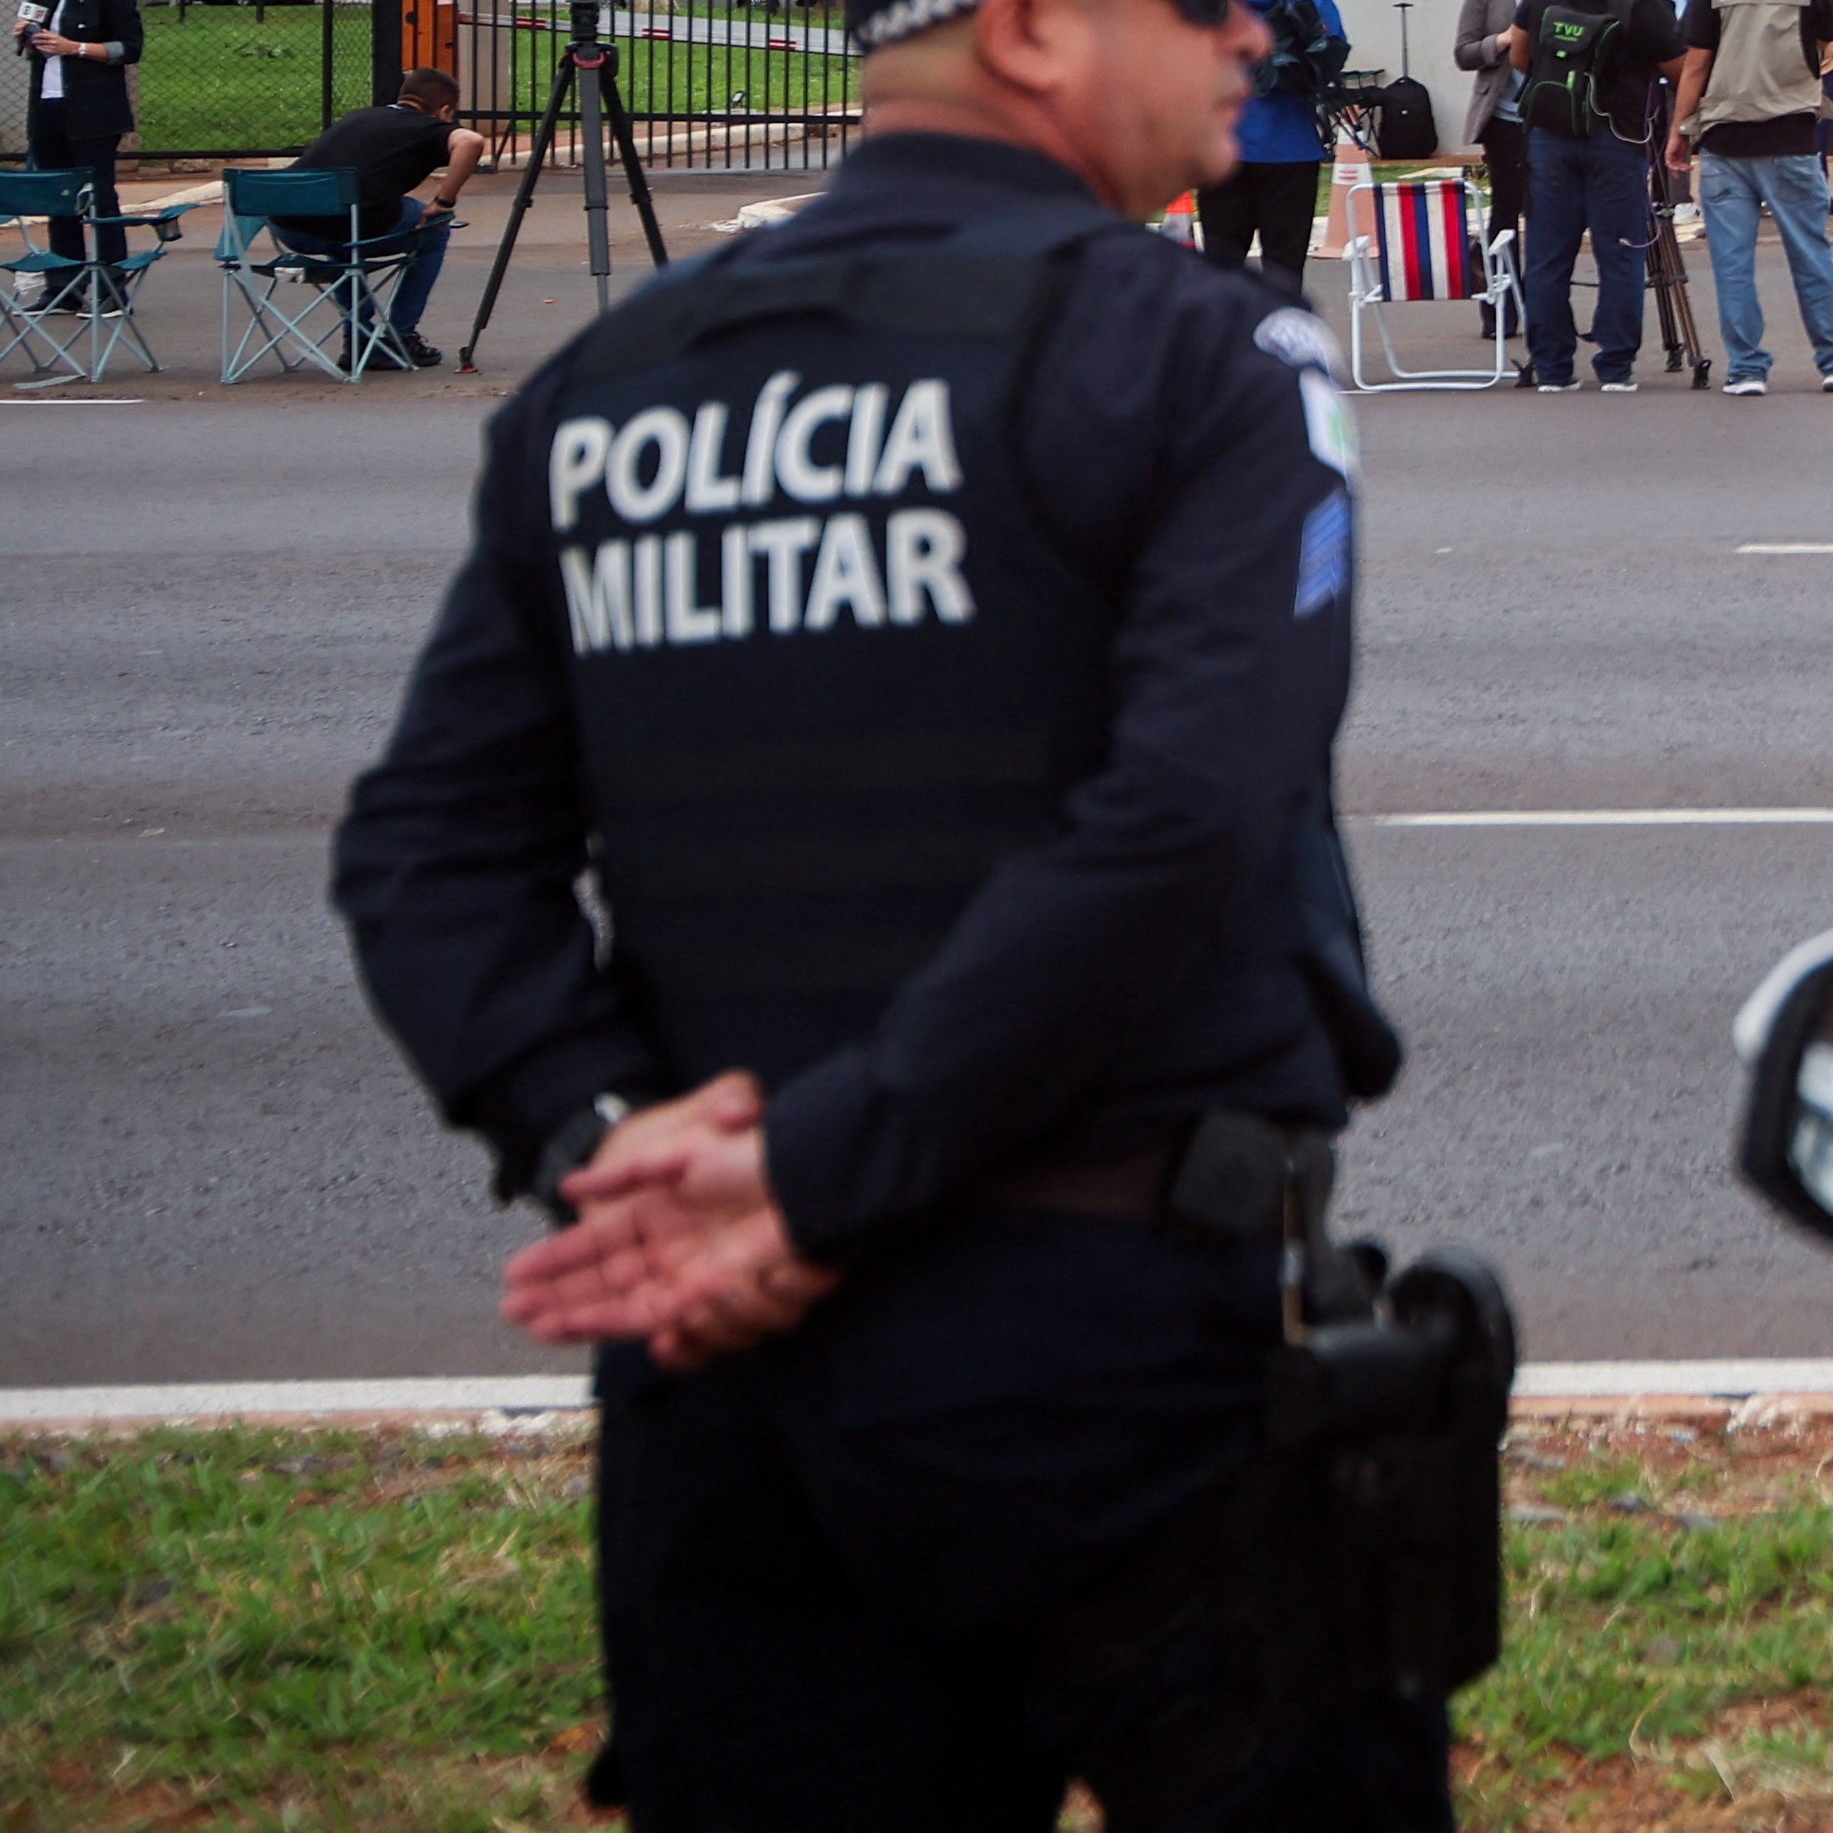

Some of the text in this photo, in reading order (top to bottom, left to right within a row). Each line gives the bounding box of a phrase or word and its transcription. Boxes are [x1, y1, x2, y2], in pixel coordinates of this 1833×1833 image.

[1553, 22, 1584, 36] TVU
[548, 370, 964, 533] POLÍCIA
[558, 506, 977, 656] MILITAR
